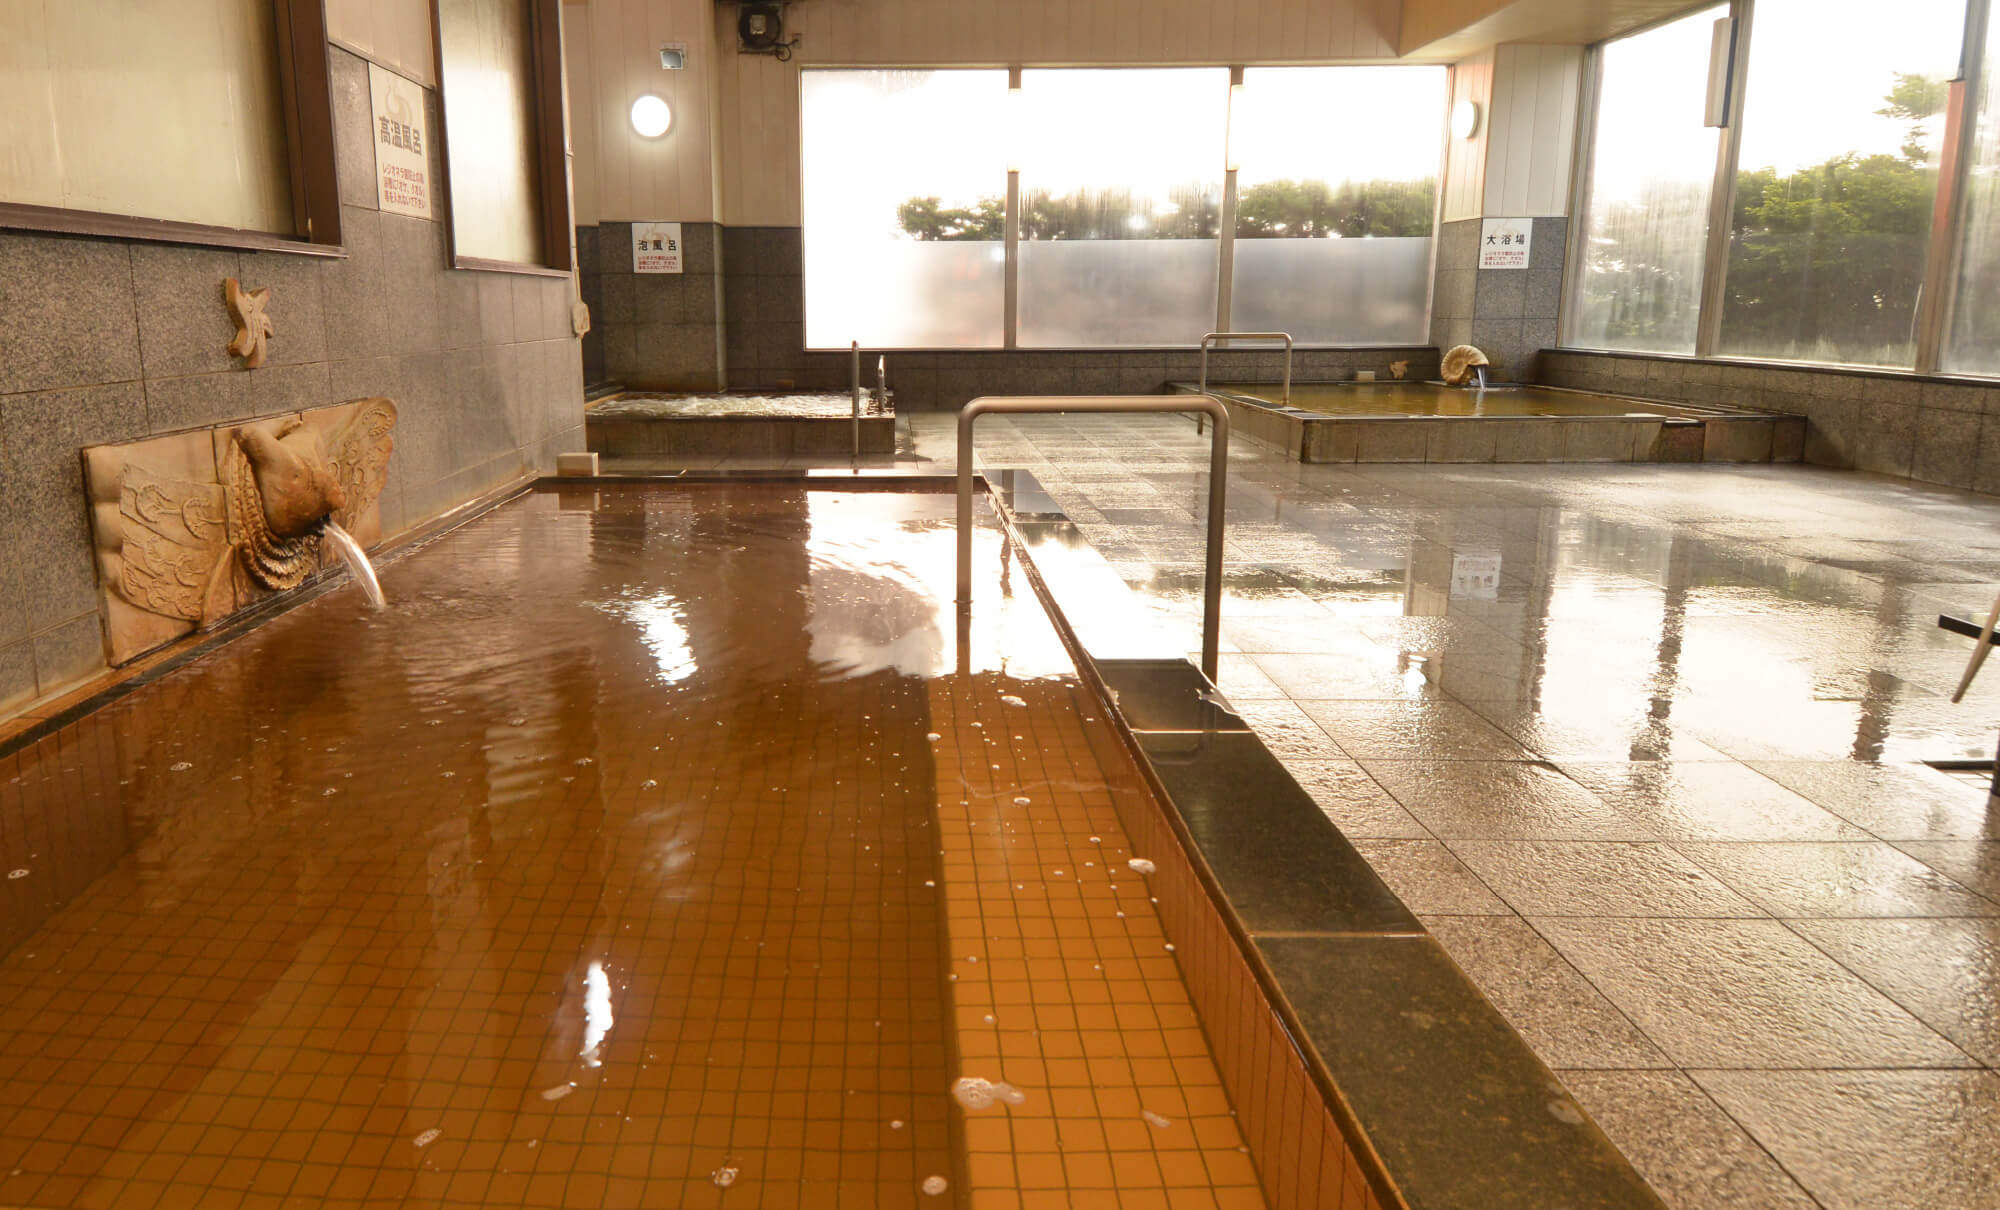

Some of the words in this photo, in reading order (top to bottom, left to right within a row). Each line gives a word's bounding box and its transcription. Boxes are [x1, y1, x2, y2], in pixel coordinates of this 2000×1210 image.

[379, 115, 422, 156] 高温風呂
[1486, 234, 1525, 245] 大浴場
[638, 240, 676, 251] 泡風呂
